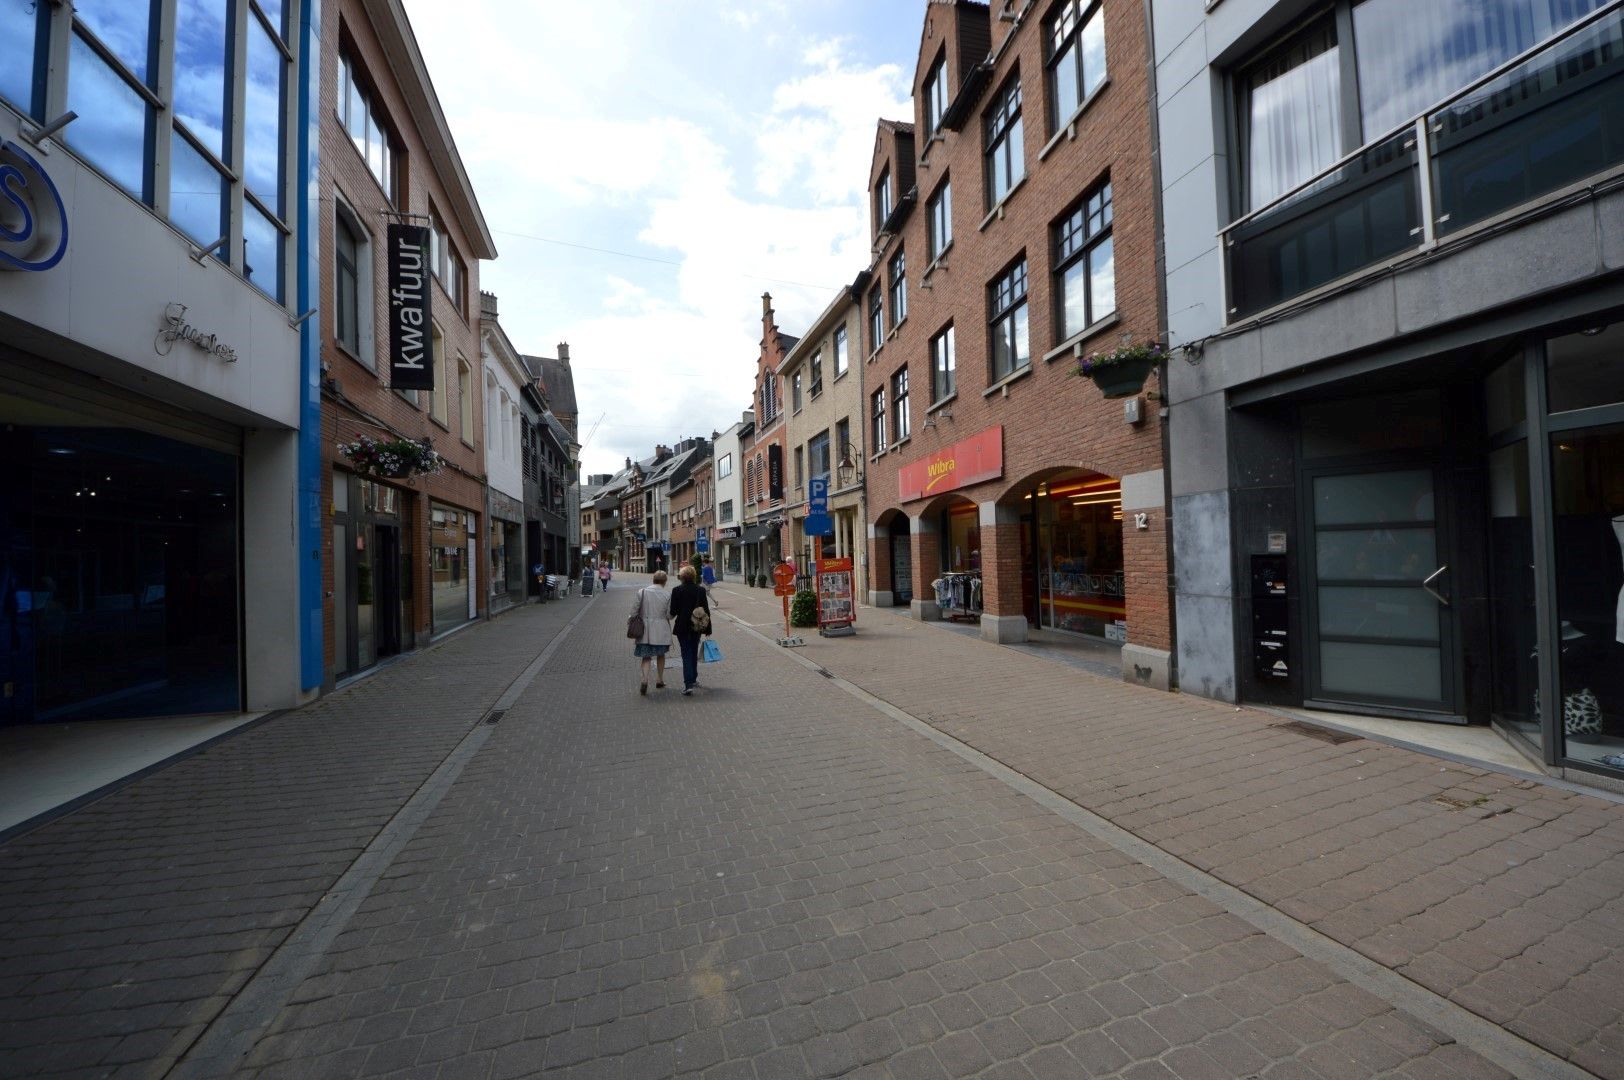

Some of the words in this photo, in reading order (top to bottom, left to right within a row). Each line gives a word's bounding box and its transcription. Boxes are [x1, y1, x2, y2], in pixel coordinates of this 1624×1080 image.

[392, 237, 424, 369] kwa'fuur
[812, 481, 824, 497] P
[1134, 512, 1148, 529] 12
[699, 529, 705, 537] P
